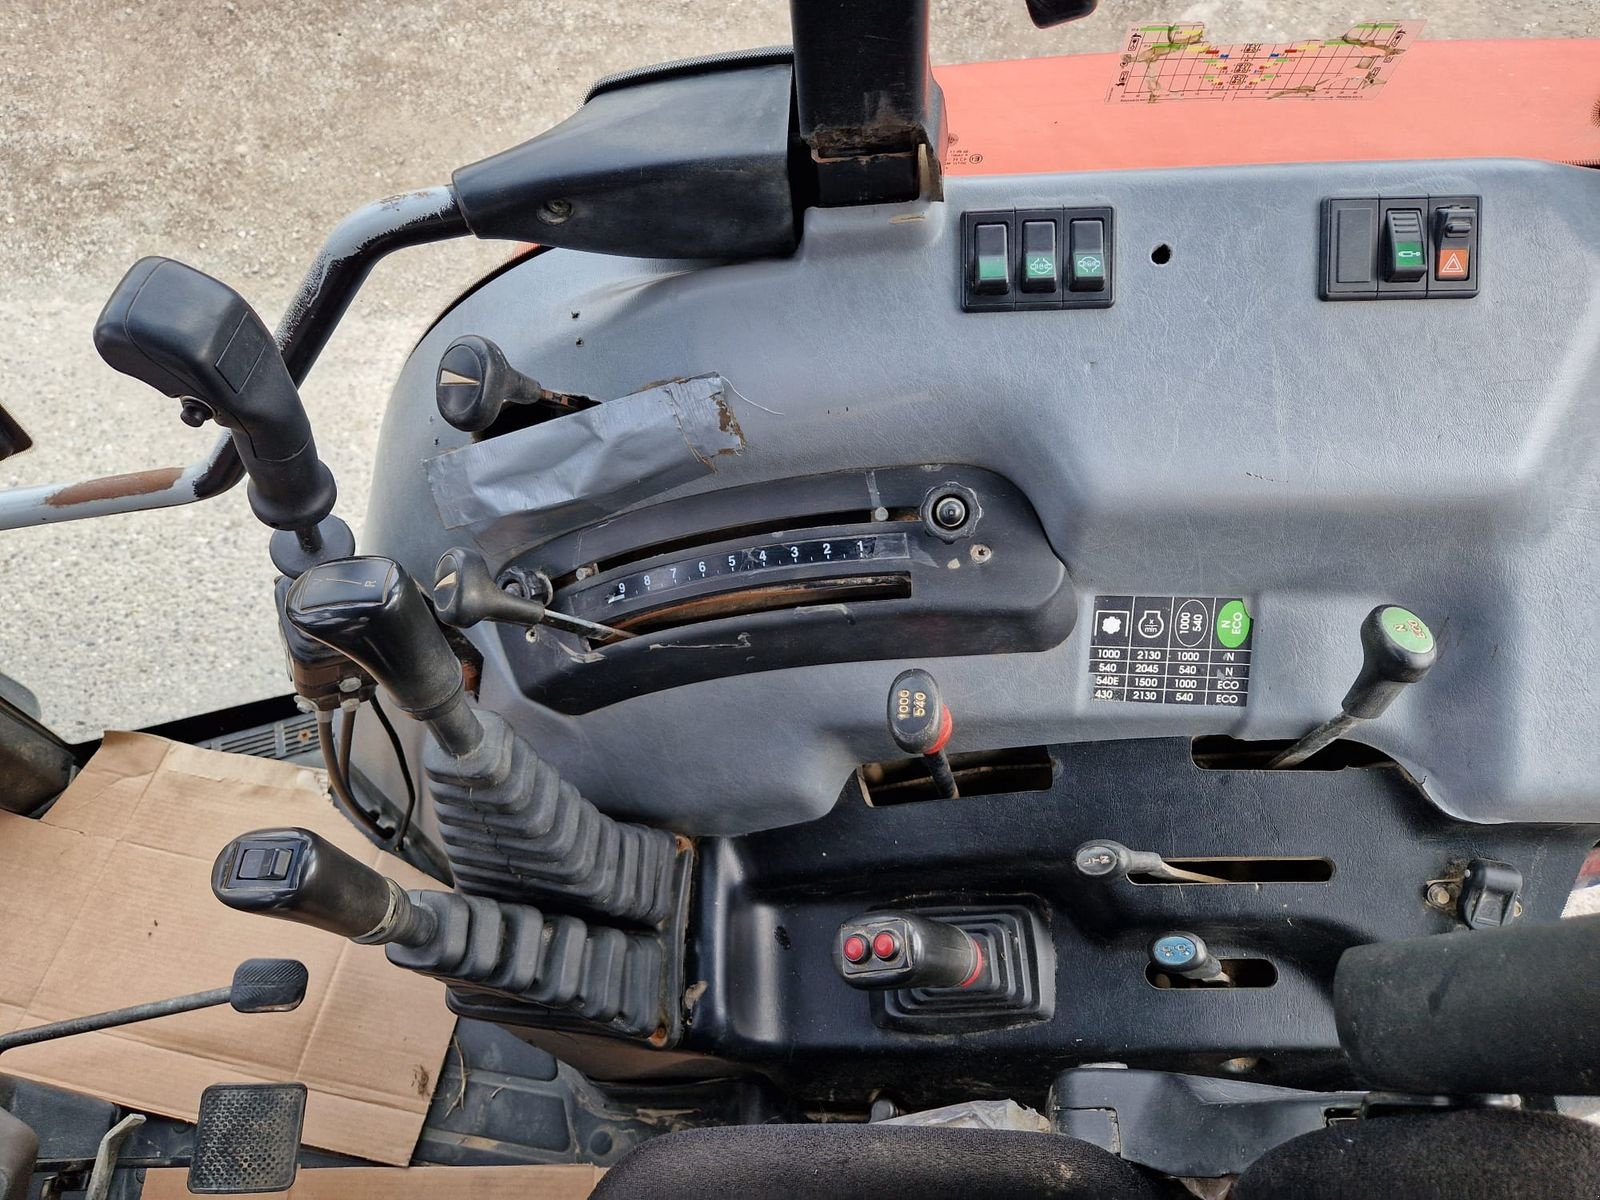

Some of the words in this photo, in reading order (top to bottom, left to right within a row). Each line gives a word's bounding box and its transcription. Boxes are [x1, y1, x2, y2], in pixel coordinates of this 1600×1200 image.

[618, 582, 625, 593] 9
[643, 575, 650, 586] 8
[669, 567, 677, 578] 7
[698, 561, 706, 572] 6
[728, 555, 736, 567] 5
[758, 550, 767, 561] 4
[790, 546, 799, 557] 3
[822, 542, 832, 554] 2
[856, 540, 863, 552] 1
[1180, 612, 1191, 634] 1000
[1193, 613, 1203, 632] 540
[1221, 619, 1231, 629] N
[1232, 612, 1243, 635] ECO
[1097, 649, 1121, 659] 1000
[1137, 650, 1161, 660] 2130
[1177, 652, 1200, 661] 1000
[1226, 652, 1235, 661] N
[1098, 663, 1117, 673] 540
[1135, 663, 1159, 673] 2045
[1178, 665, 1197, 674] 540
[1225, 667, 1233, 676] N
[1096, 676, 1119, 686] 540E
[1134, 677, 1158, 687] 1500
[1174, 679, 1197, 689] 1000
[1217, 680, 1240, 690] ECO
[897, 689, 910, 720] 1000
[913, 692, 927, 717] 540
[1094, 689, 1113, 699] 430
[1132, 691, 1157, 700] 2130
[1175, 692, 1194, 702] 540
[1215, 694, 1238, 704] ECO
